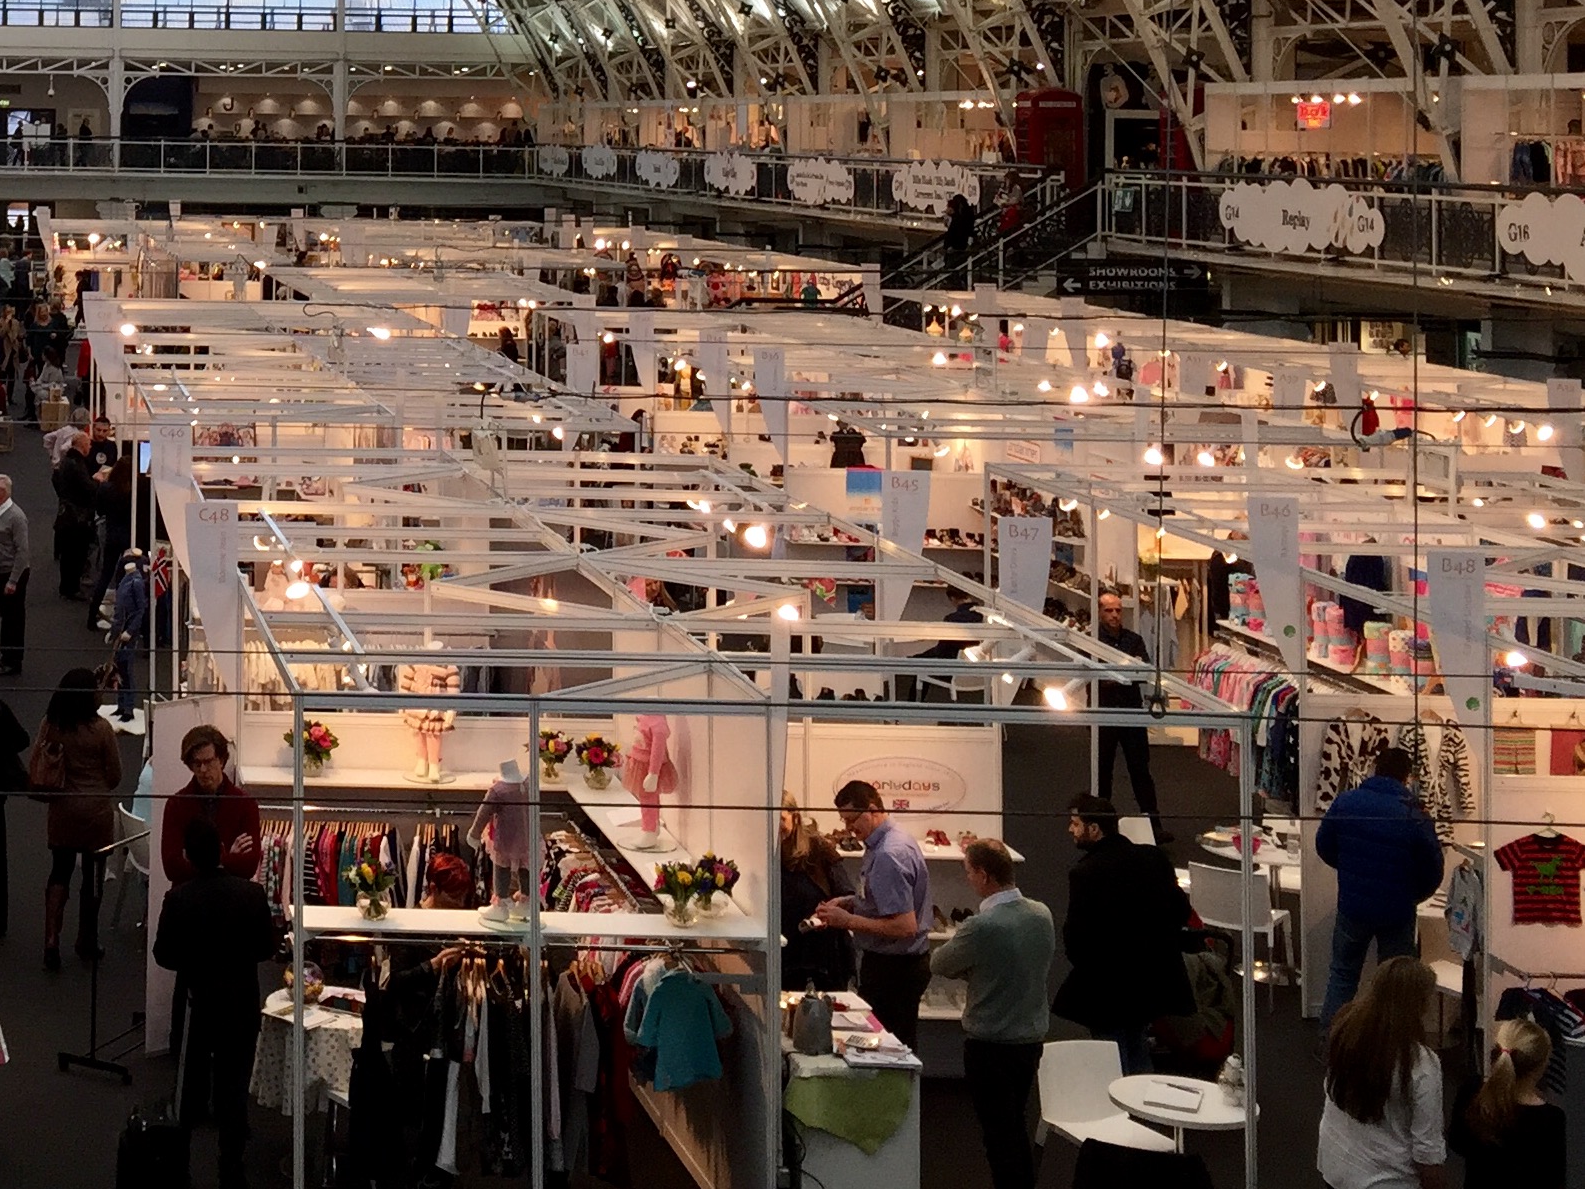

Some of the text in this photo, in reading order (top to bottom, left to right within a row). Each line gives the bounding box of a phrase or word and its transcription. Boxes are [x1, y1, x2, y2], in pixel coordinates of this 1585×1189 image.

[1225, 205, 1375, 232] G14 Replay G14
[1508, 222, 1531, 243] G16
[1088, 266, 1176, 278] SHOWROOMS
[1088, 280, 1176, 291] EXHIBITIONS
[160, 426, 185, 438] C46
[891, 476, 919, 492] B45
[199, 507, 230, 524] C48
[1260, 503, 1291, 520] B46
[1008, 523, 1040, 541] B47
[1441, 557, 1477, 575] B48
[871, 779, 941, 792] arlydays
